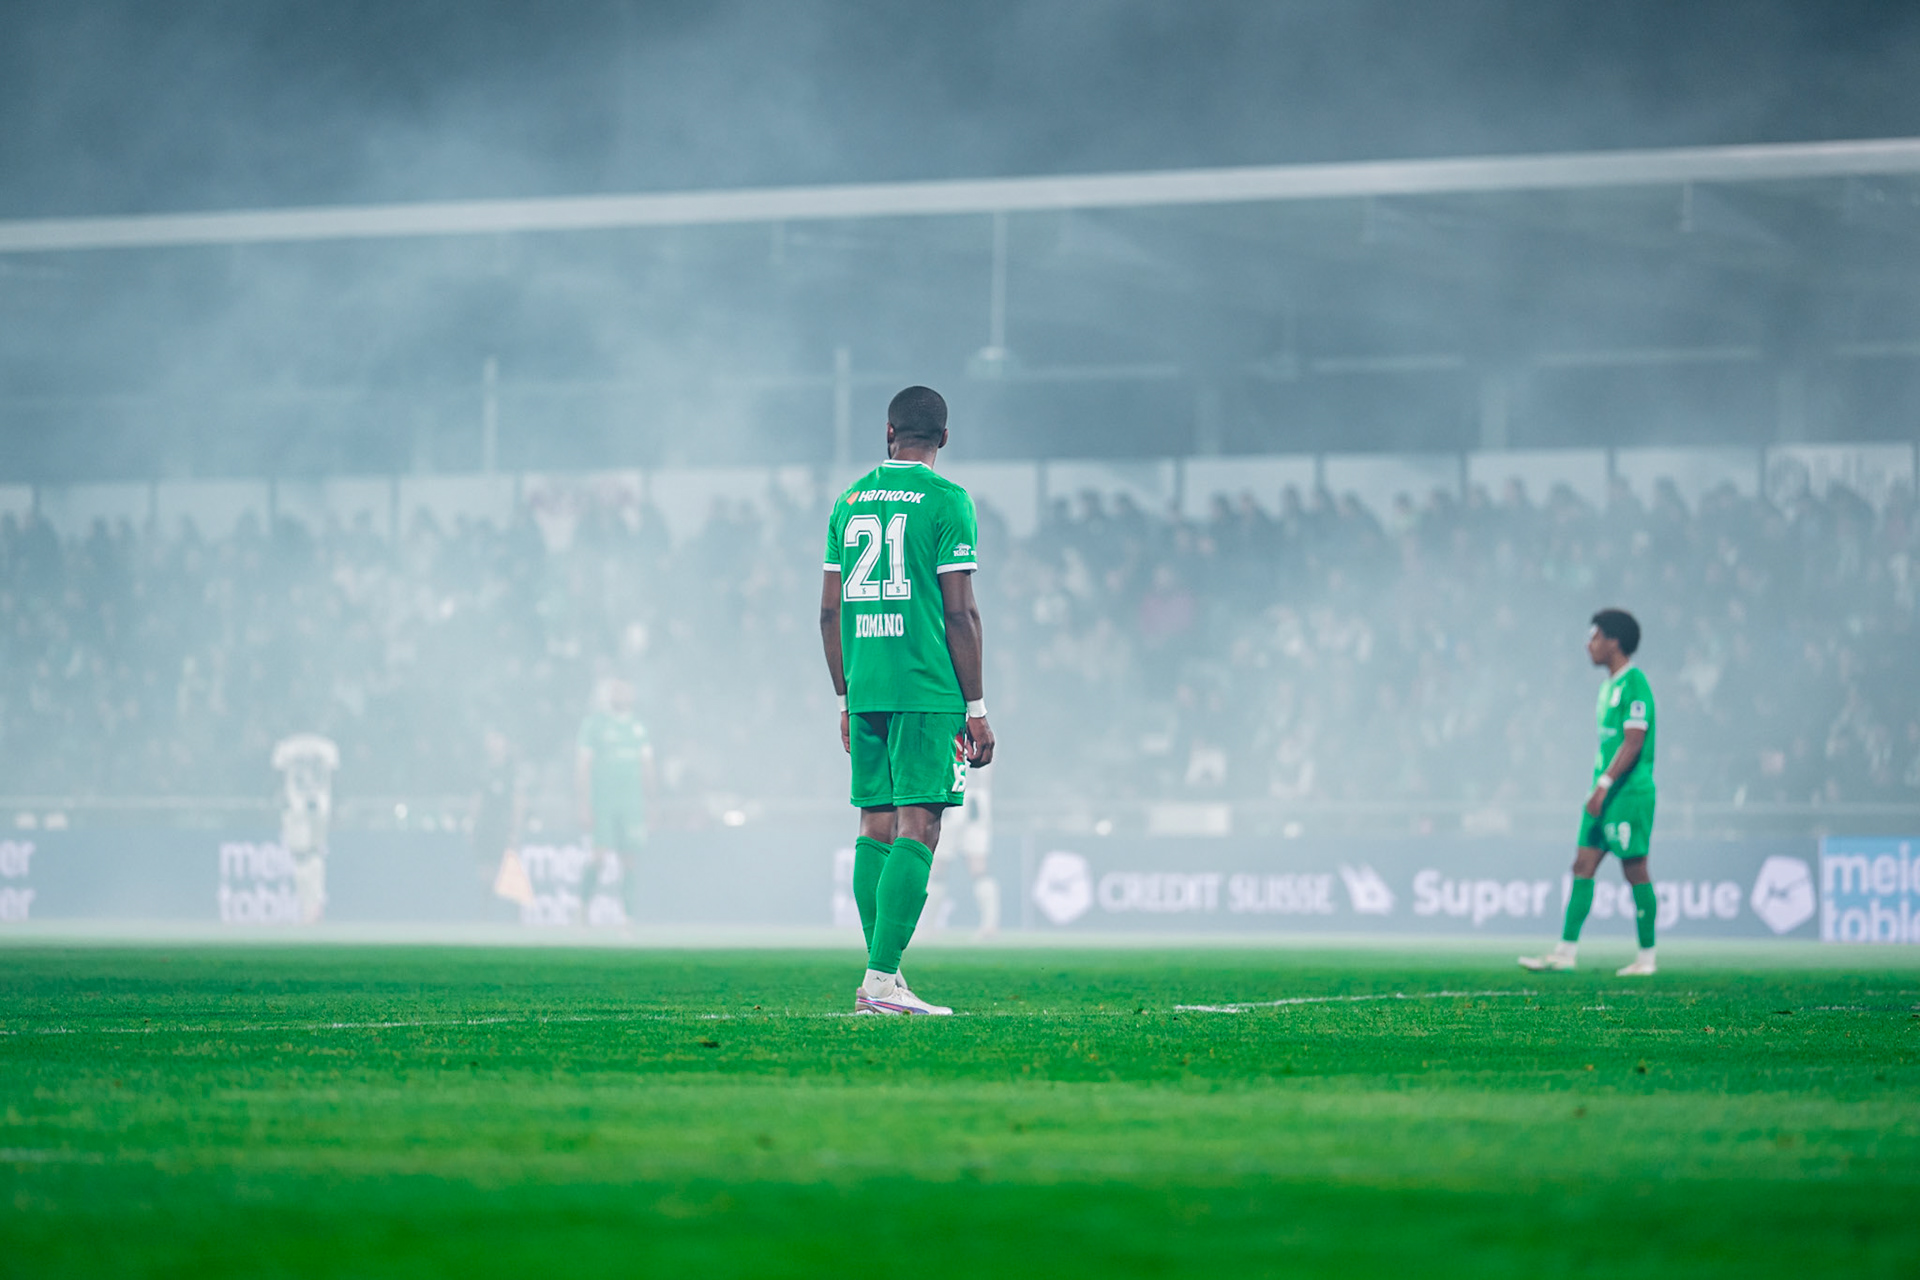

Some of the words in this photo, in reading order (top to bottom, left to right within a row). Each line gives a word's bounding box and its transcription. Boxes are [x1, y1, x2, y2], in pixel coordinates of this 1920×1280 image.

[843, 513, 911, 602] 21
[855, 613, 904, 638] KOMANO
[1100, 871, 1222, 912] CREDIT
[1228, 872, 1335, 914] SUISSE
[1412, 868, 1551, 927] Super
